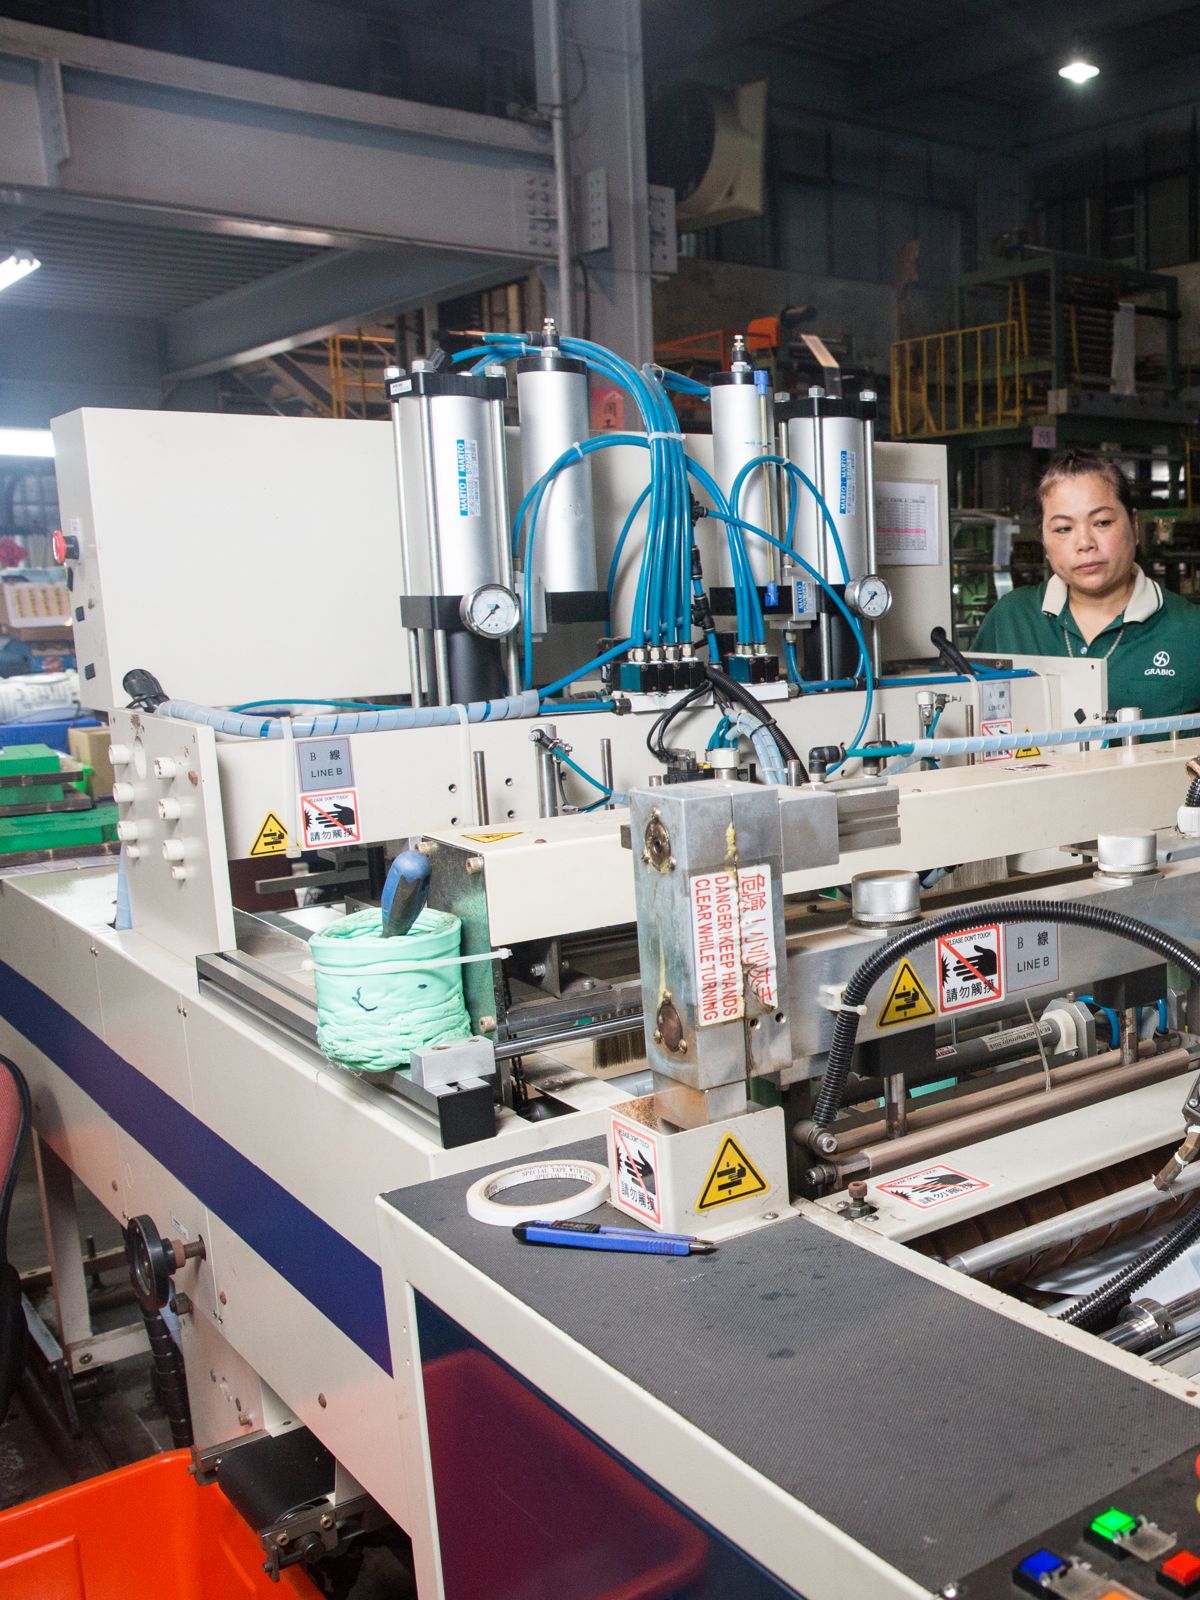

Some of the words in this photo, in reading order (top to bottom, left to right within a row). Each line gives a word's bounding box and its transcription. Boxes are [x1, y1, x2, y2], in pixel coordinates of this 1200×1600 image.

[457, 443, 466, 472] MARTO
[459, 483, 467, 511] MARTO
[1143, 668, 1176, 677] GRABIO
[310, 752, 317, 761] B
[310, 768, 334, 778] LINE
[336, 768, 343, 776] B
[695, 878, 712, 922] CLEAR
[698, 922, 715, 964] WHILE
[964, 935, 977, 943] DON'T
[977, 931, 992, 940] TOUCH
[1017, 937, 1024, 949] B
[1037, 931, 1049, 946] 線
[1017, 958, 1041, 973] LINE
[1043, 956, 1050, 966] B
[700, 964, 719, 1021] TURNING
[721, 973, 738, 1017] HANDS
[946, 979, 994, 1003] 請勿觸摸
[522, 1167, 547, 1177] SPECIAL
